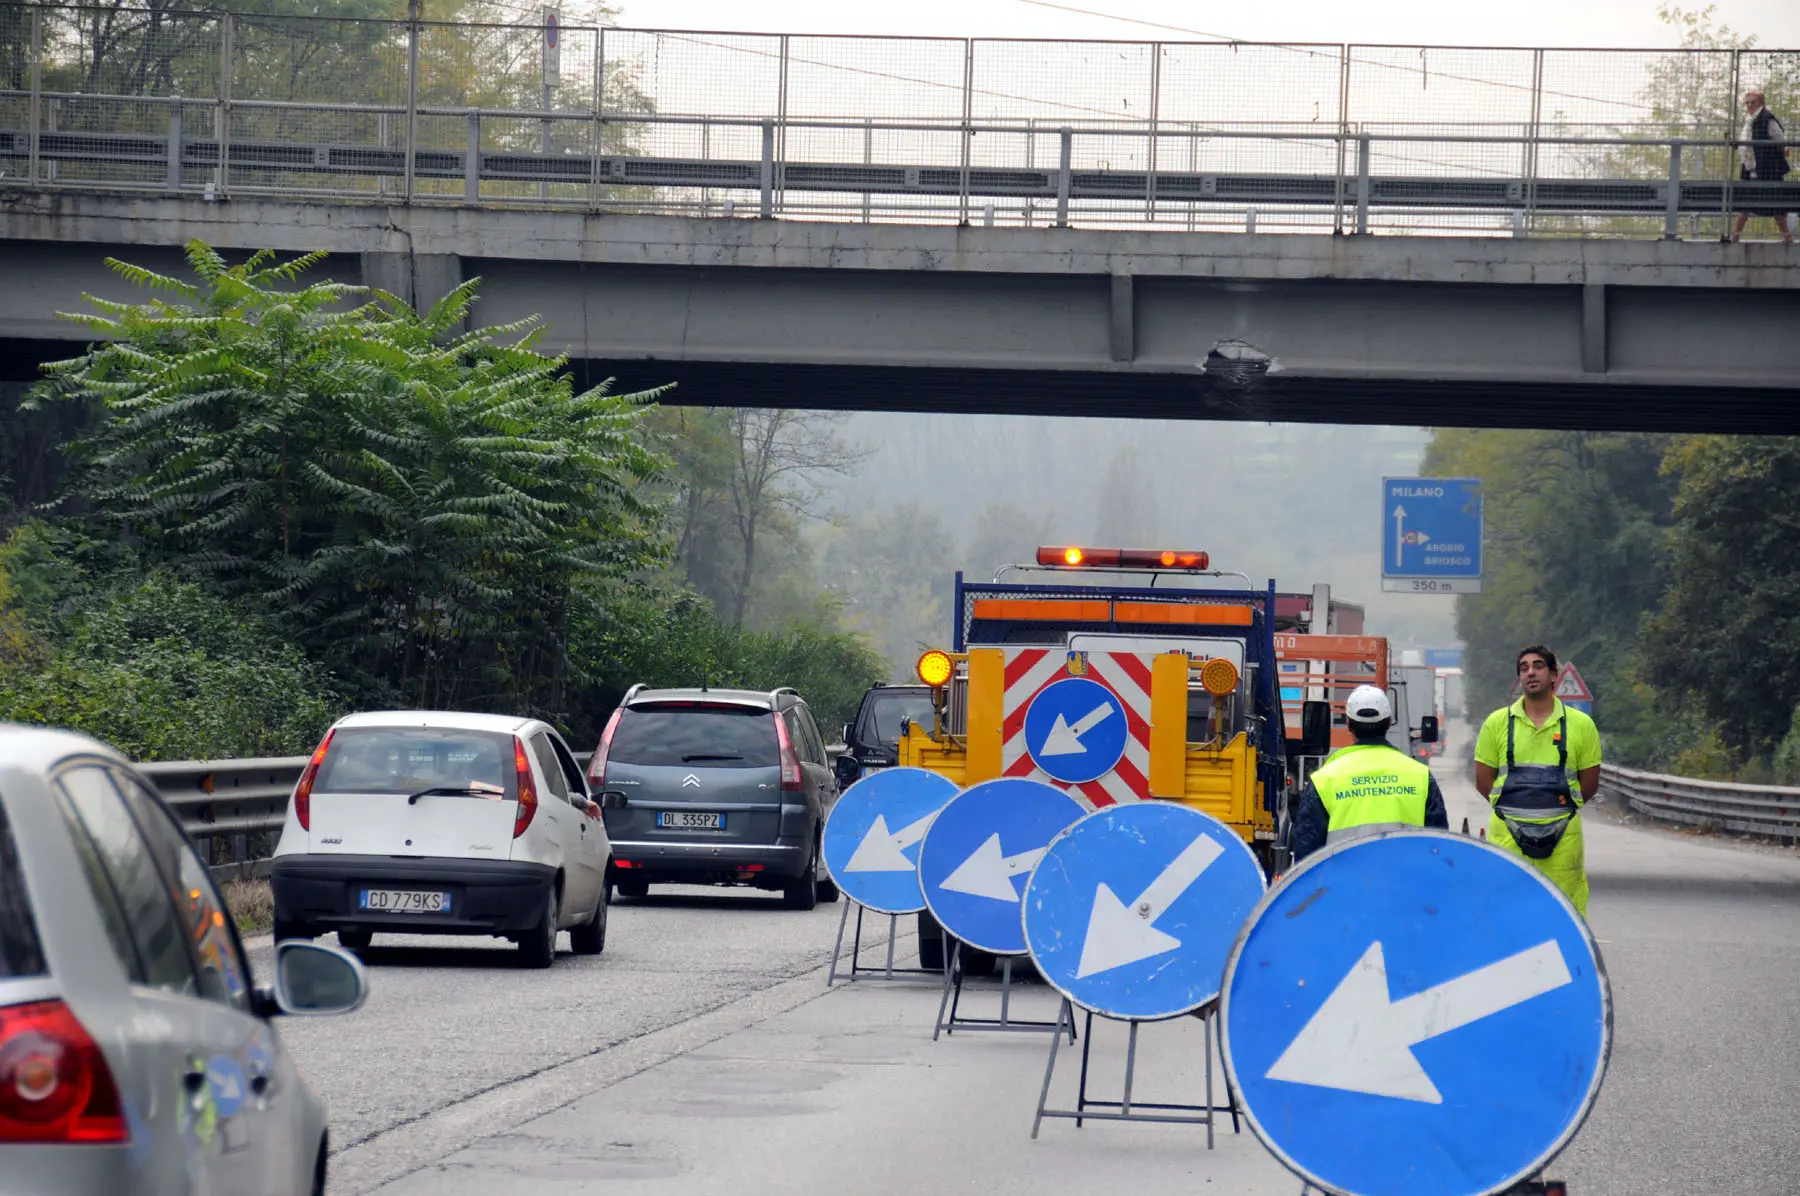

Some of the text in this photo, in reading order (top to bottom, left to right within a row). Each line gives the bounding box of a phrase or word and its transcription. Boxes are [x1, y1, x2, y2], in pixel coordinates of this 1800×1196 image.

[1392, 487, 1444, 497] MILANO
[1412, 581, 1437, 590] 350
[1351, 775, 1398, 786] SERVIZIO
[1335, 786, 1417, 800] MANUTENZIONE
[663, 813, 718, 827] DL 335PZ
[369, 892, 388, 908] CD
[393, 892, 441, 909] 779KS
